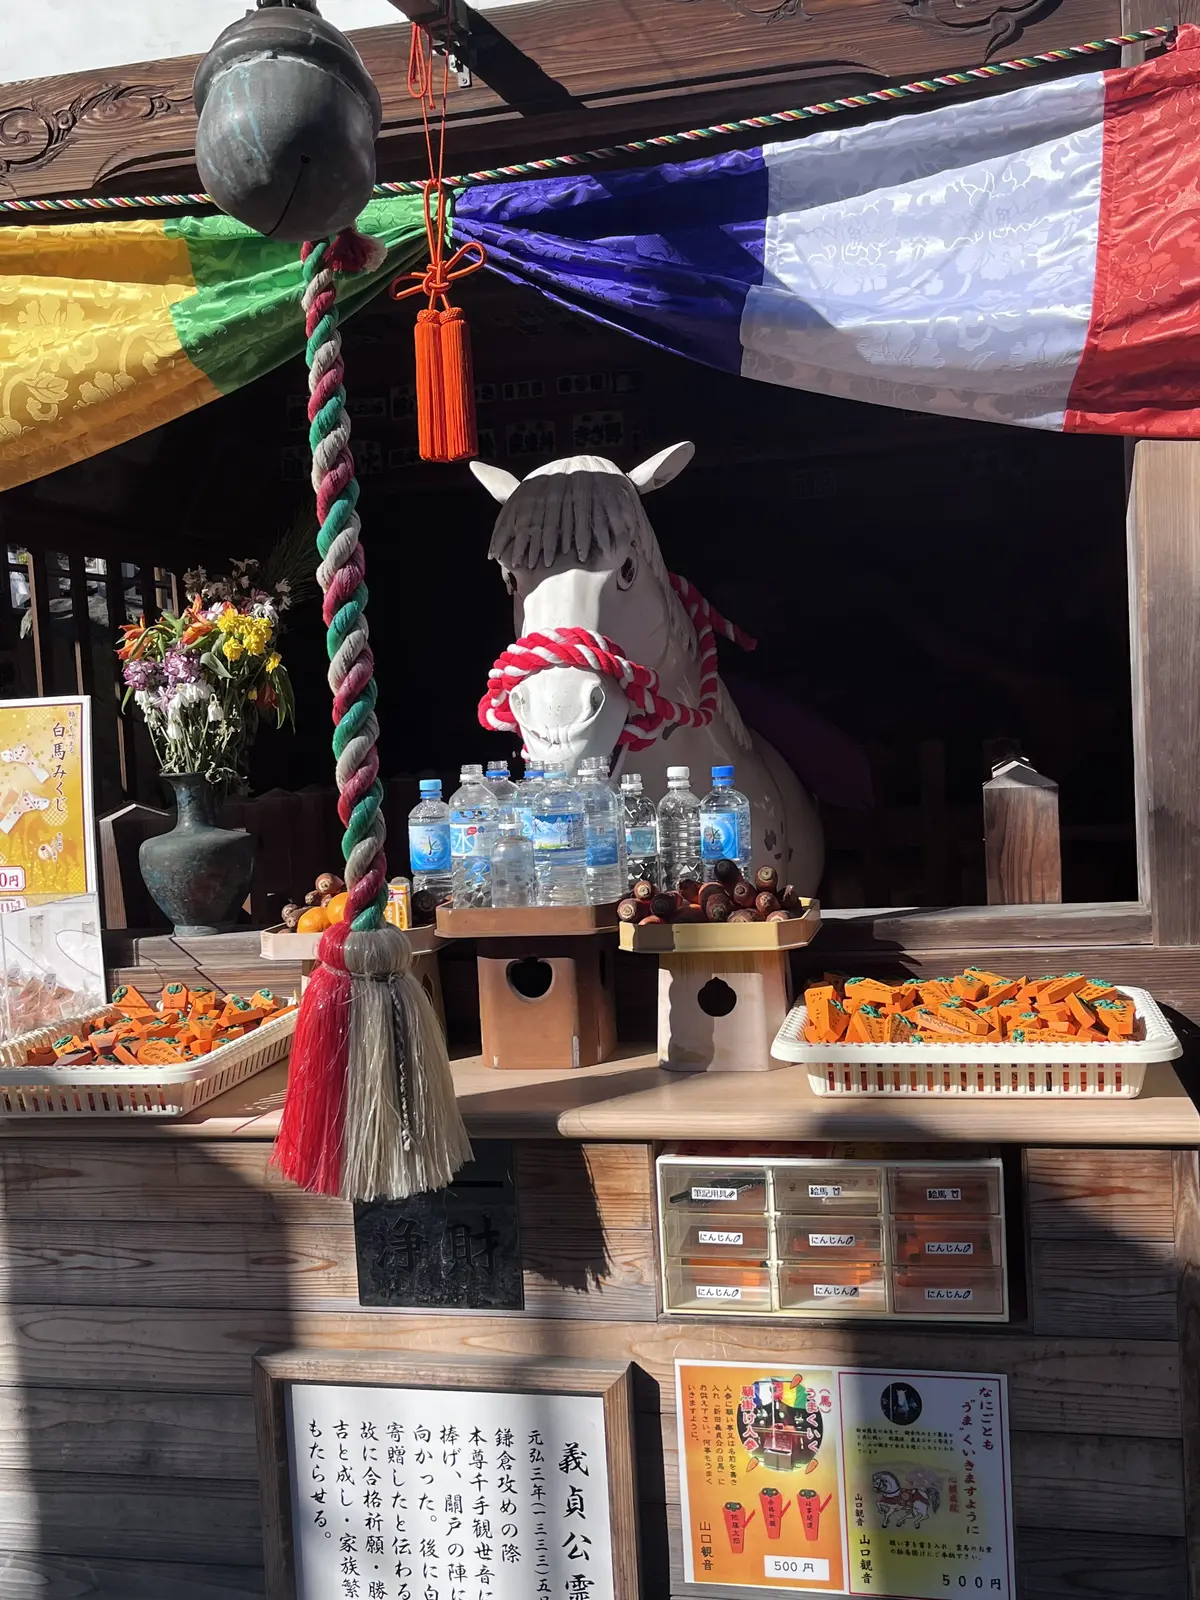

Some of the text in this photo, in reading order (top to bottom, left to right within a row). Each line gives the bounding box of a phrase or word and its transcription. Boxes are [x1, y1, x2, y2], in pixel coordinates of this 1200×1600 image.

[51, 722, 67, 813] 白馬みくじ
[455, 827, 474, 853] 水
[693, 1188, 727, 1200] 筆記用具
[810, 1186, 829, 1197] 絵馬
[928, 1190, 947, 1200] 絵馬
[699, 1233, 733, 1244] にんじん
[811, 1235, 845, 1246] にんじん
[927, 1244, 962, 1254] にんじん
[697, 1287, 731, 1298] にんじん
[814, 1286, 849, 1297] にんじん
[927, 1289, 962, 1300] にんじん
[687, 1384, 699, 1442] いきますように。
[740, 1385, 760, 1452] 願掛け人参
[805, 1387, 822, 1453] うまくいく
[978, 1386, 994, 1451] なにごとも
[308, 1419, 332, 1540] もたらせる。
[494, 1428, 522, 1564] 鎌倉攻めの際
[332, 1420, 361, 1599] 吉と成し・家族繁
[360, 1421, 388, 1600] 故に合格祈願・勝
[386, 1422, 412, 1600] 寄贈したと伝わる
[468, 1426, 496, 1600] 本尊千手観世音に
[854, 1493, 865, 1527] 山口観音
[699, 1520, 714, 1571] 山口観音
[858, 1534, 873, 1584] 山口観音
